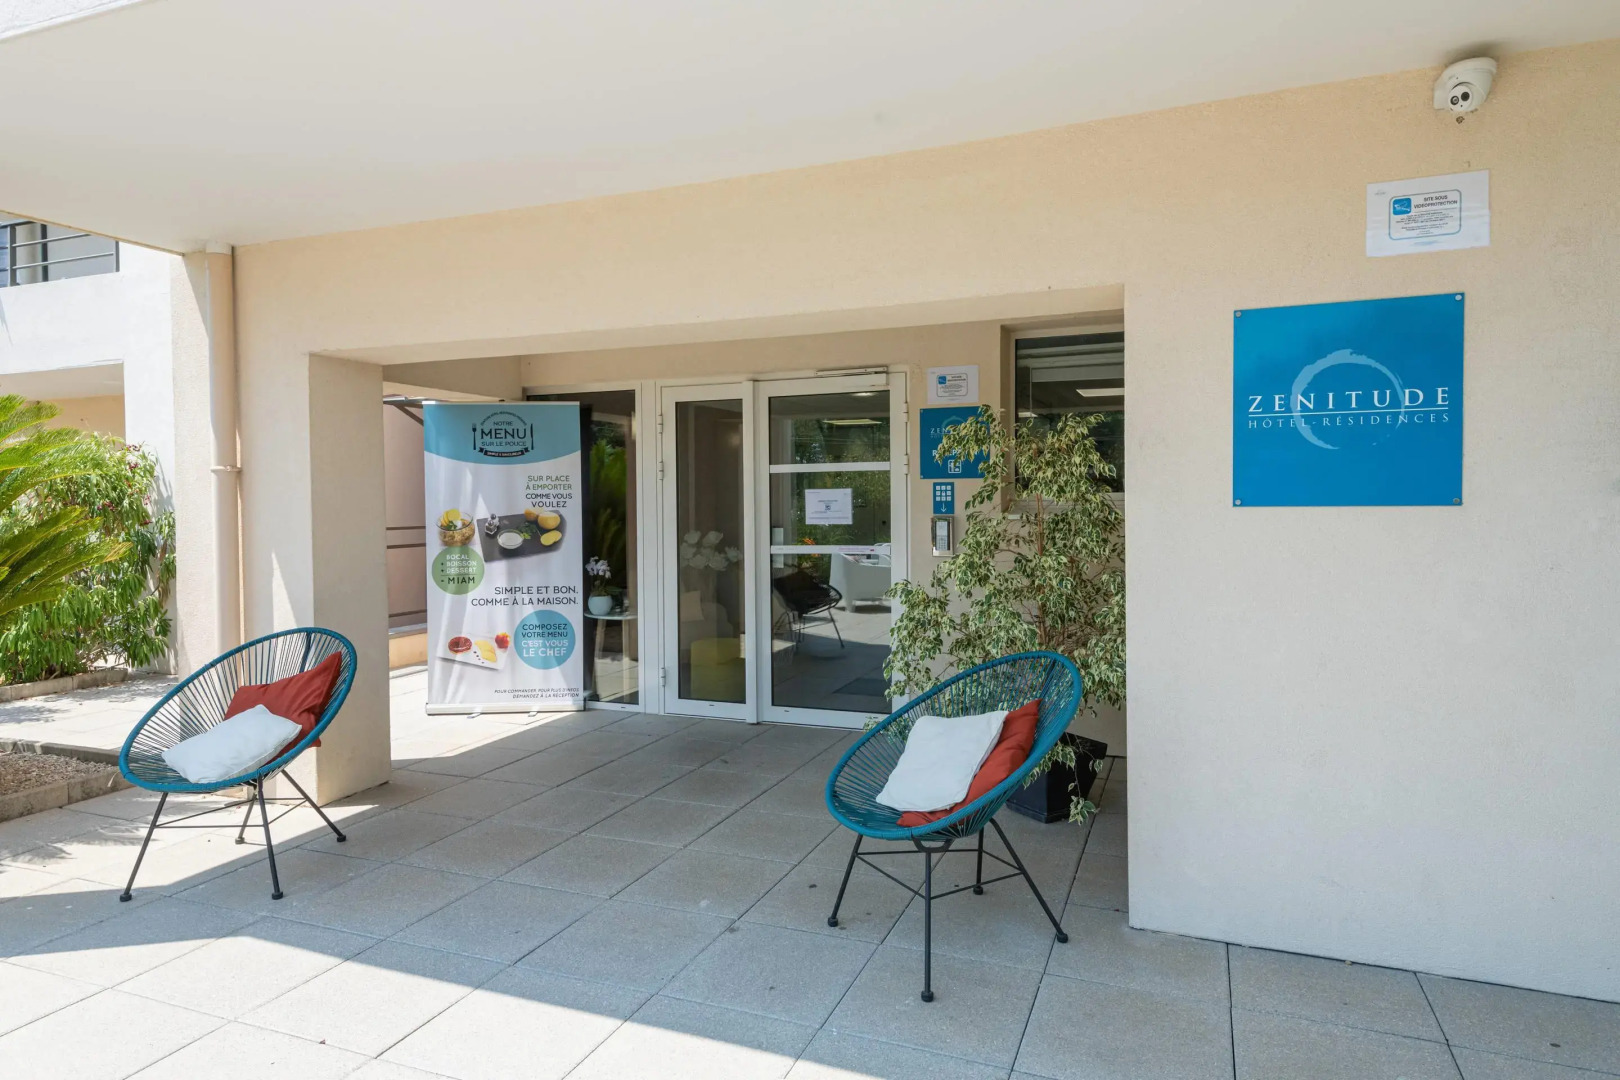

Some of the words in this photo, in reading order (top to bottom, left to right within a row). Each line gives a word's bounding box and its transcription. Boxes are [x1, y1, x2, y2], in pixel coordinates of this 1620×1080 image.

[1248, 387, 1449, 412] ZENITUDE
[1248, 413, 1449, 428] HÔTEL-RÉSIDENCES
[481, 428, 526, 439] MENU
[526, 482, 531, 490] À
[471, 598, 509, 606] COMME
[512, 596, 519, 606] À
[537, 597, 578, 605] MAISON.
[523, 648, 535, 657] LE
[539, 648, 567, 656] CHEF
